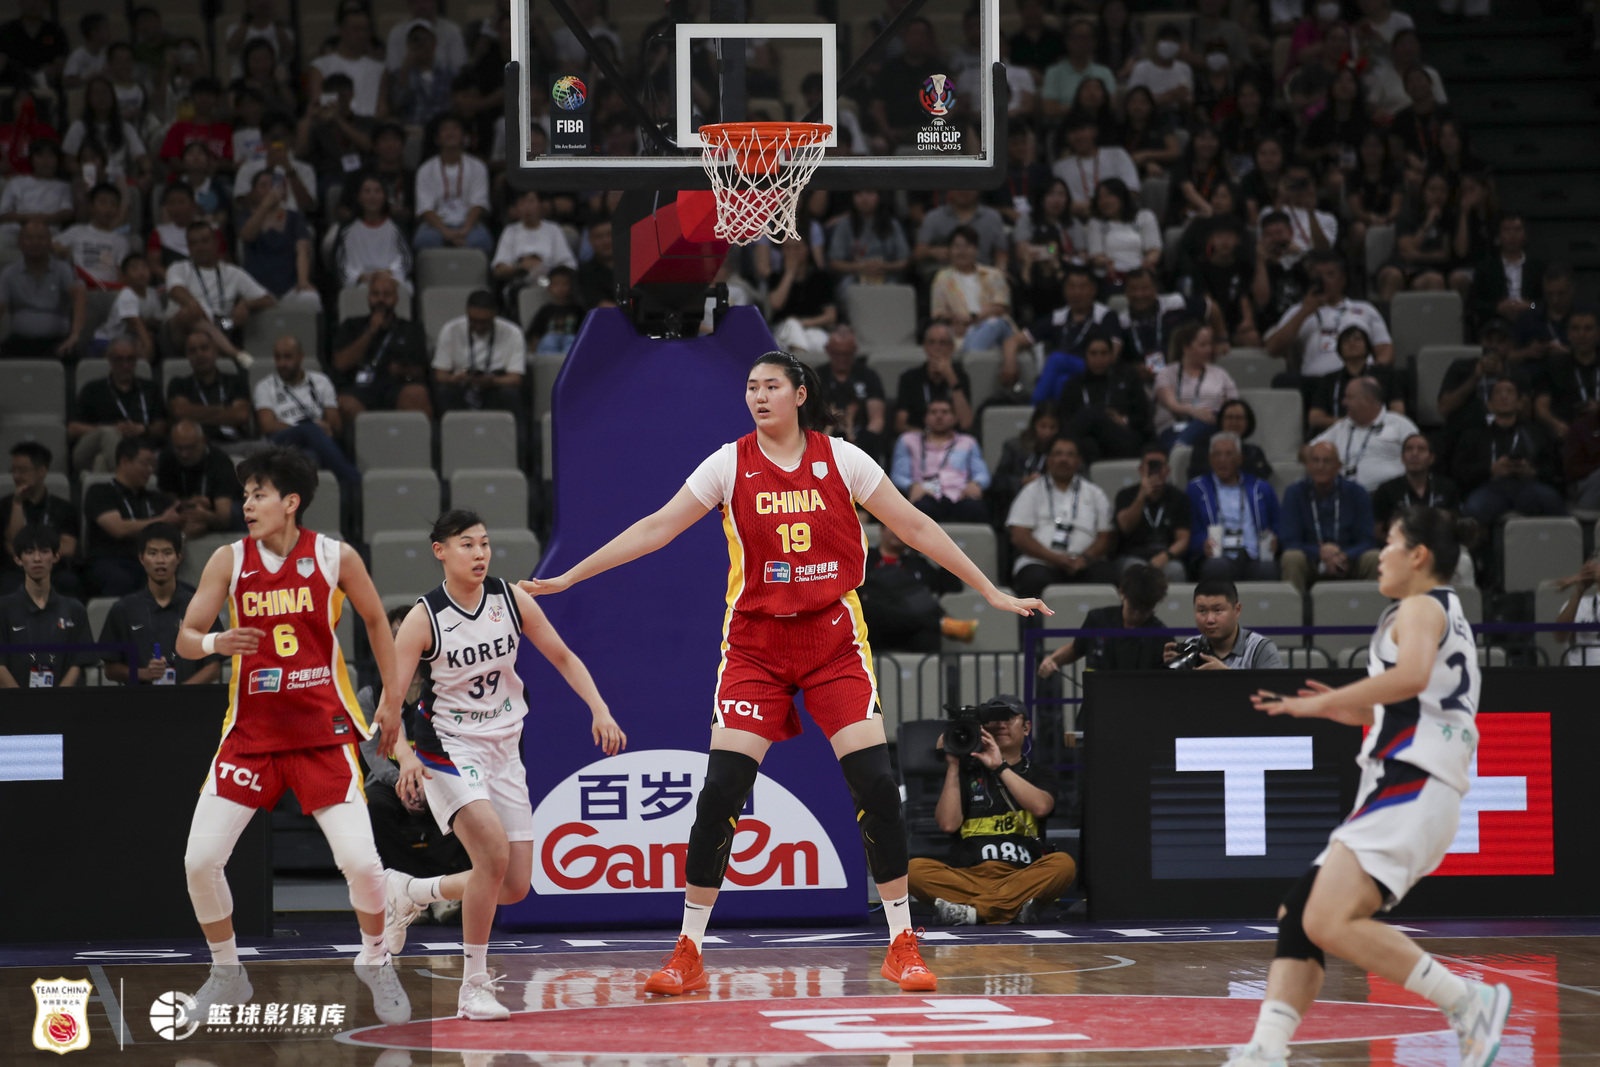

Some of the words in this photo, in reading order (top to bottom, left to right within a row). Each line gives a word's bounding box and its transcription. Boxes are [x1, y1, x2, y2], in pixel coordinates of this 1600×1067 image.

[556, 119, 584, 133] FIBA
[917, 132, 939, 143] ASIA
[942, 132, 961, 143] CUP
[756, 489, 826, 514] CHINA
[776, 522, 811, 553] 19
[795, 561, 838, 575] 中国银联
[811, 573, 838, 582] UnionPay
[242, 586, 314, 617] CHINA
[273, 624, 299, 657] 6
[447, 634, 516, 668] KOREA
[287, 682, 305, 690] China
[468, 671, 501, 699] 39
[721, 699, 763, 721] TCL
[219, 761, 263, 792] TCL
[578, 771, 754, 821] 百岁
[541, 818, 819, 890] Ganen
[759, 998, 1092, 1050] TCL
